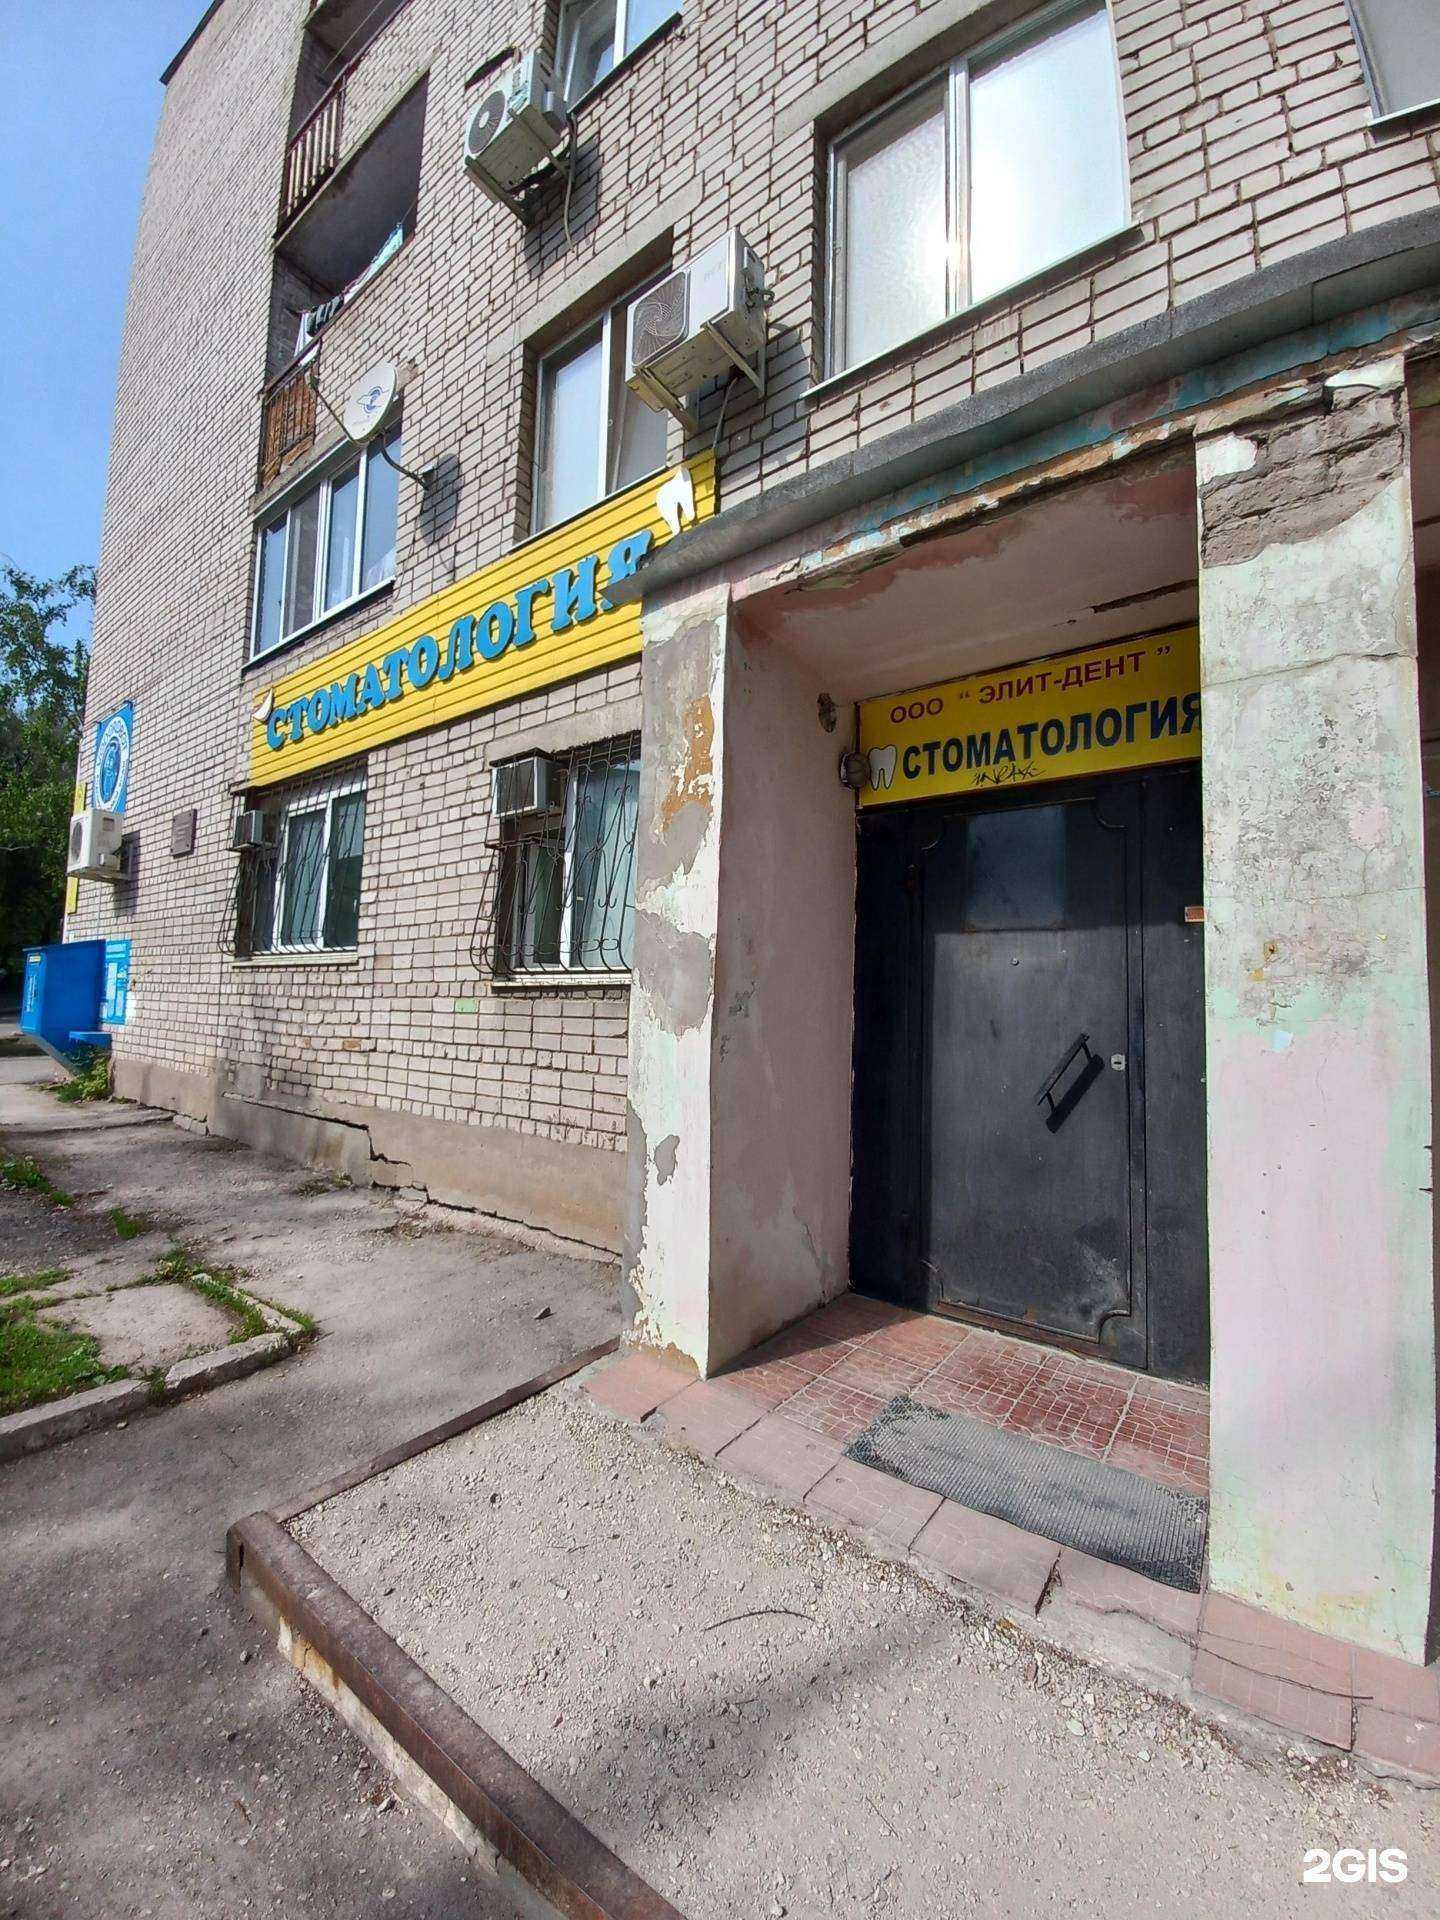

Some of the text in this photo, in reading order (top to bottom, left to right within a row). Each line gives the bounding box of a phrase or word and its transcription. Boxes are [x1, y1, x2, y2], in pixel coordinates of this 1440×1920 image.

[266, 529, 652, 750] СТОМАТОЛОГИЯ
[890, 697, 944, 724] ООО
[902, 691, 1200, 779] СТОМАТОЛОГИЯ
